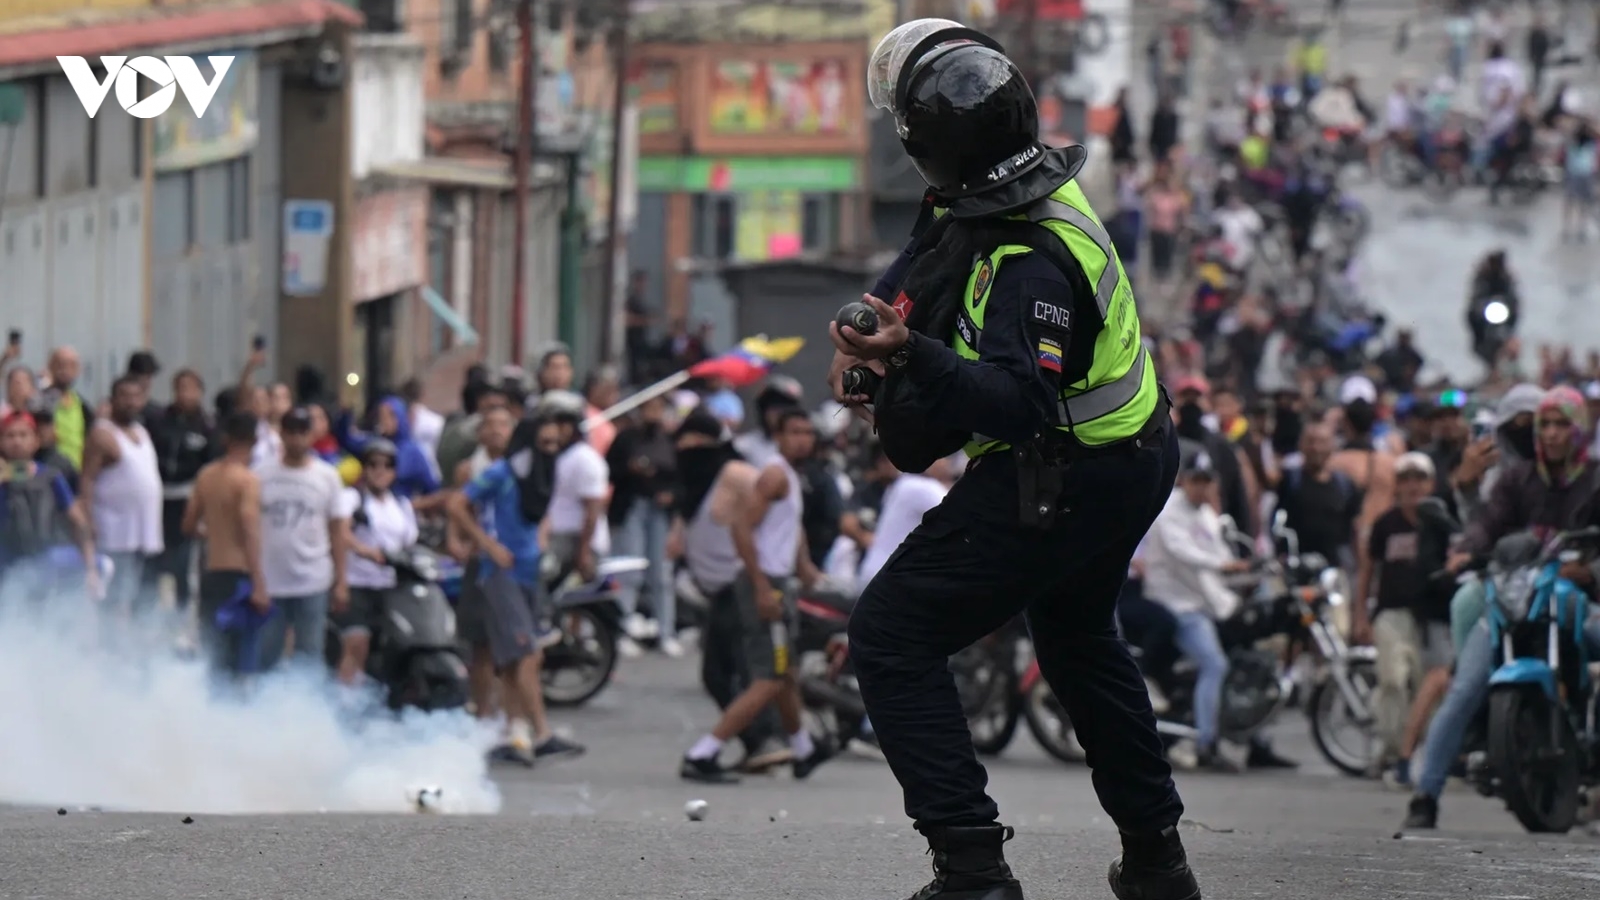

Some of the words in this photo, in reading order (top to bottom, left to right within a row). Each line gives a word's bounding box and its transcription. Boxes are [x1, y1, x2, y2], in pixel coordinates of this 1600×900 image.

[991, 166, 1008, 181] LA
[1017, 145, 1040, 166] VEGA
[1034, 300, 1070, 330] CPNB
